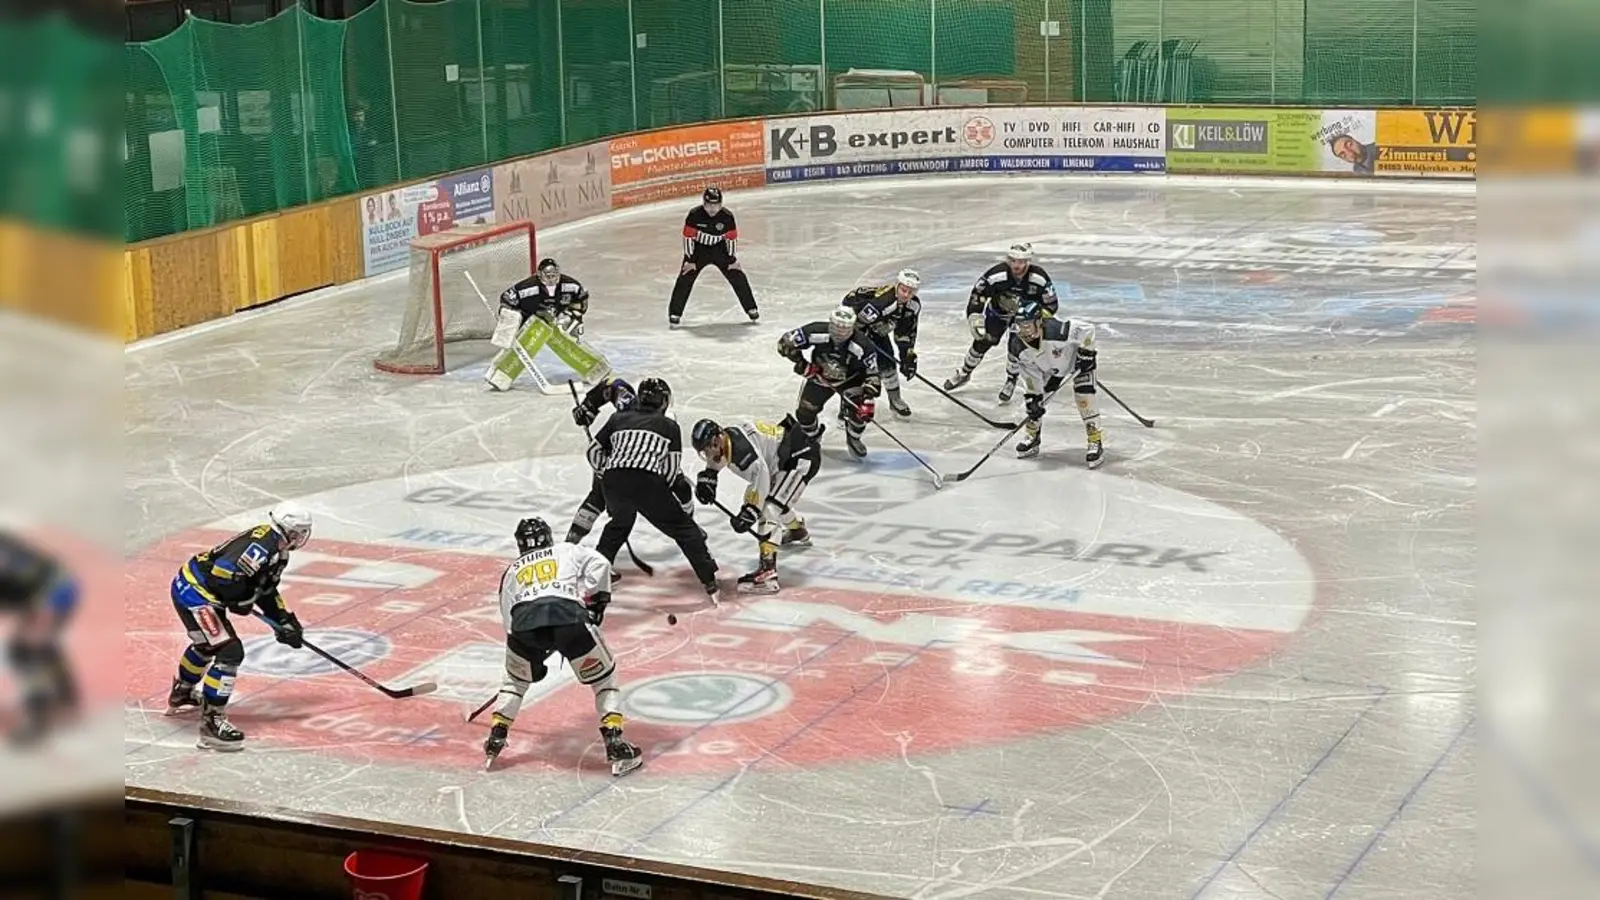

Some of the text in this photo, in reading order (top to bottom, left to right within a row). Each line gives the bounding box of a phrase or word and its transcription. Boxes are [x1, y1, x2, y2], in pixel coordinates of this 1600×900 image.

[848, 126, 957, 150] expert
[1003, 123, 1160, 133] TV DVD HIFI CAR-HIFI CD
[1198, 123, 1264, 142] KEIL&LÖW
[770, 125, 837, 161] K+B
[1003, 138, 1160, 149] COMPUTER TELEKOM HAUSHALT
[1379, 147, 1447, 161] Zimmerei
[804, 166, 826, 179] REGEN
[898, 159, 950, 172] SCHWANDORF
[960, 158, 990, 168] AMBERG
[1000, 158, 1050, 168] WALDKIRCHEN
[1062, 158, 1095, 168] ILMENAU
[453, 180, 480, 197] Allianz
[578, 179, 605, 204] NM
[541, 189, 567, 214] NM
[513, 549, 554, 571] STURM
